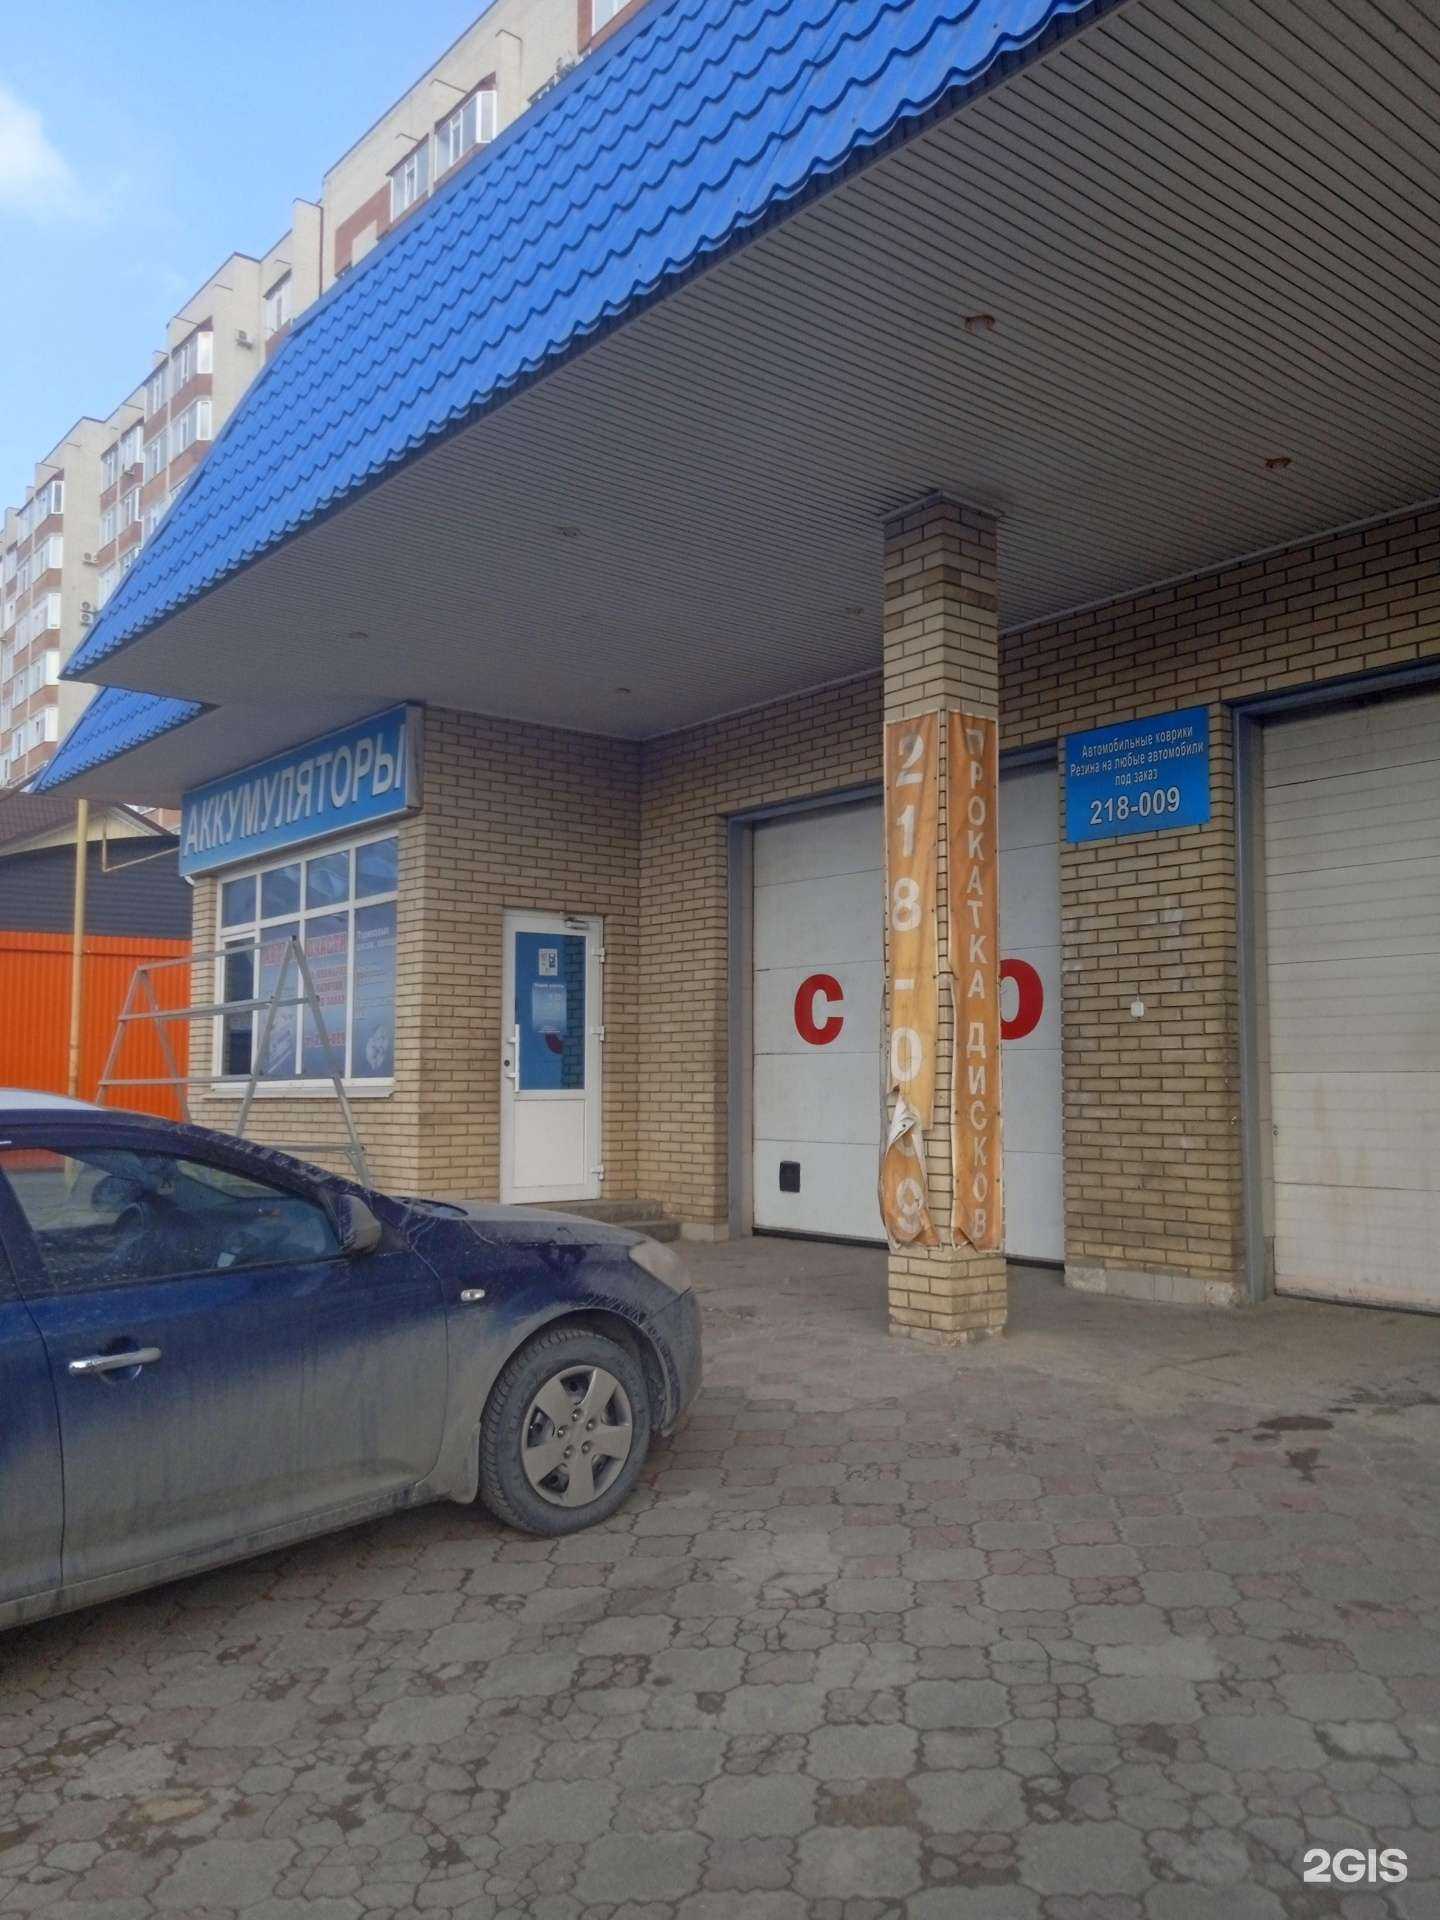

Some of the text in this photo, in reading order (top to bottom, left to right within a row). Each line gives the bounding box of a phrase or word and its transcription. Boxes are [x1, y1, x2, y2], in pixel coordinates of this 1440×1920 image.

[1070, 741, 1204, 777] Резина на любые автомобили
[1081, 725, 1194, 760] Автомобильные коврики
[183, 723, 406, 857] АККУМУЛЯТОРЫ
[1115, 768, 1159, 787] под заказ
[1089, 786, 1181, 825] 218-009
[965, 727, 989, 1239] ПРОКАТКА ДИСКОВ
